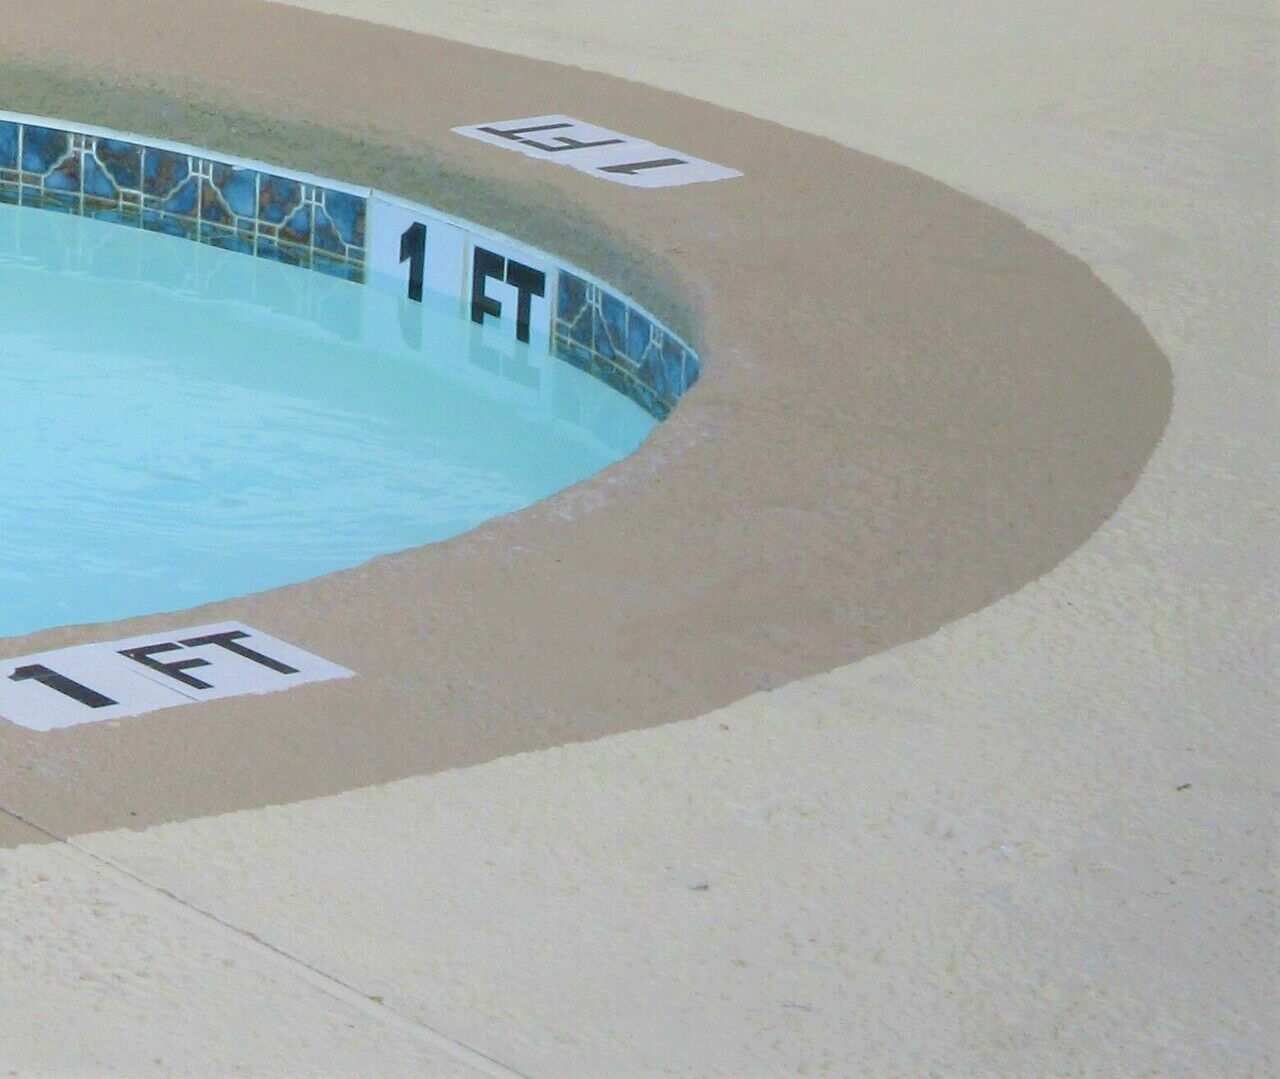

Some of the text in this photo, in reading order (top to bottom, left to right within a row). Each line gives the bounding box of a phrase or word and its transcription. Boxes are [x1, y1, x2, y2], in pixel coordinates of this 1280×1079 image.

[477, 122, 689, 176] 1 FT
[399, 221, 546, 344] 1 FT
[8, 630, 300, 709] 1 FT
